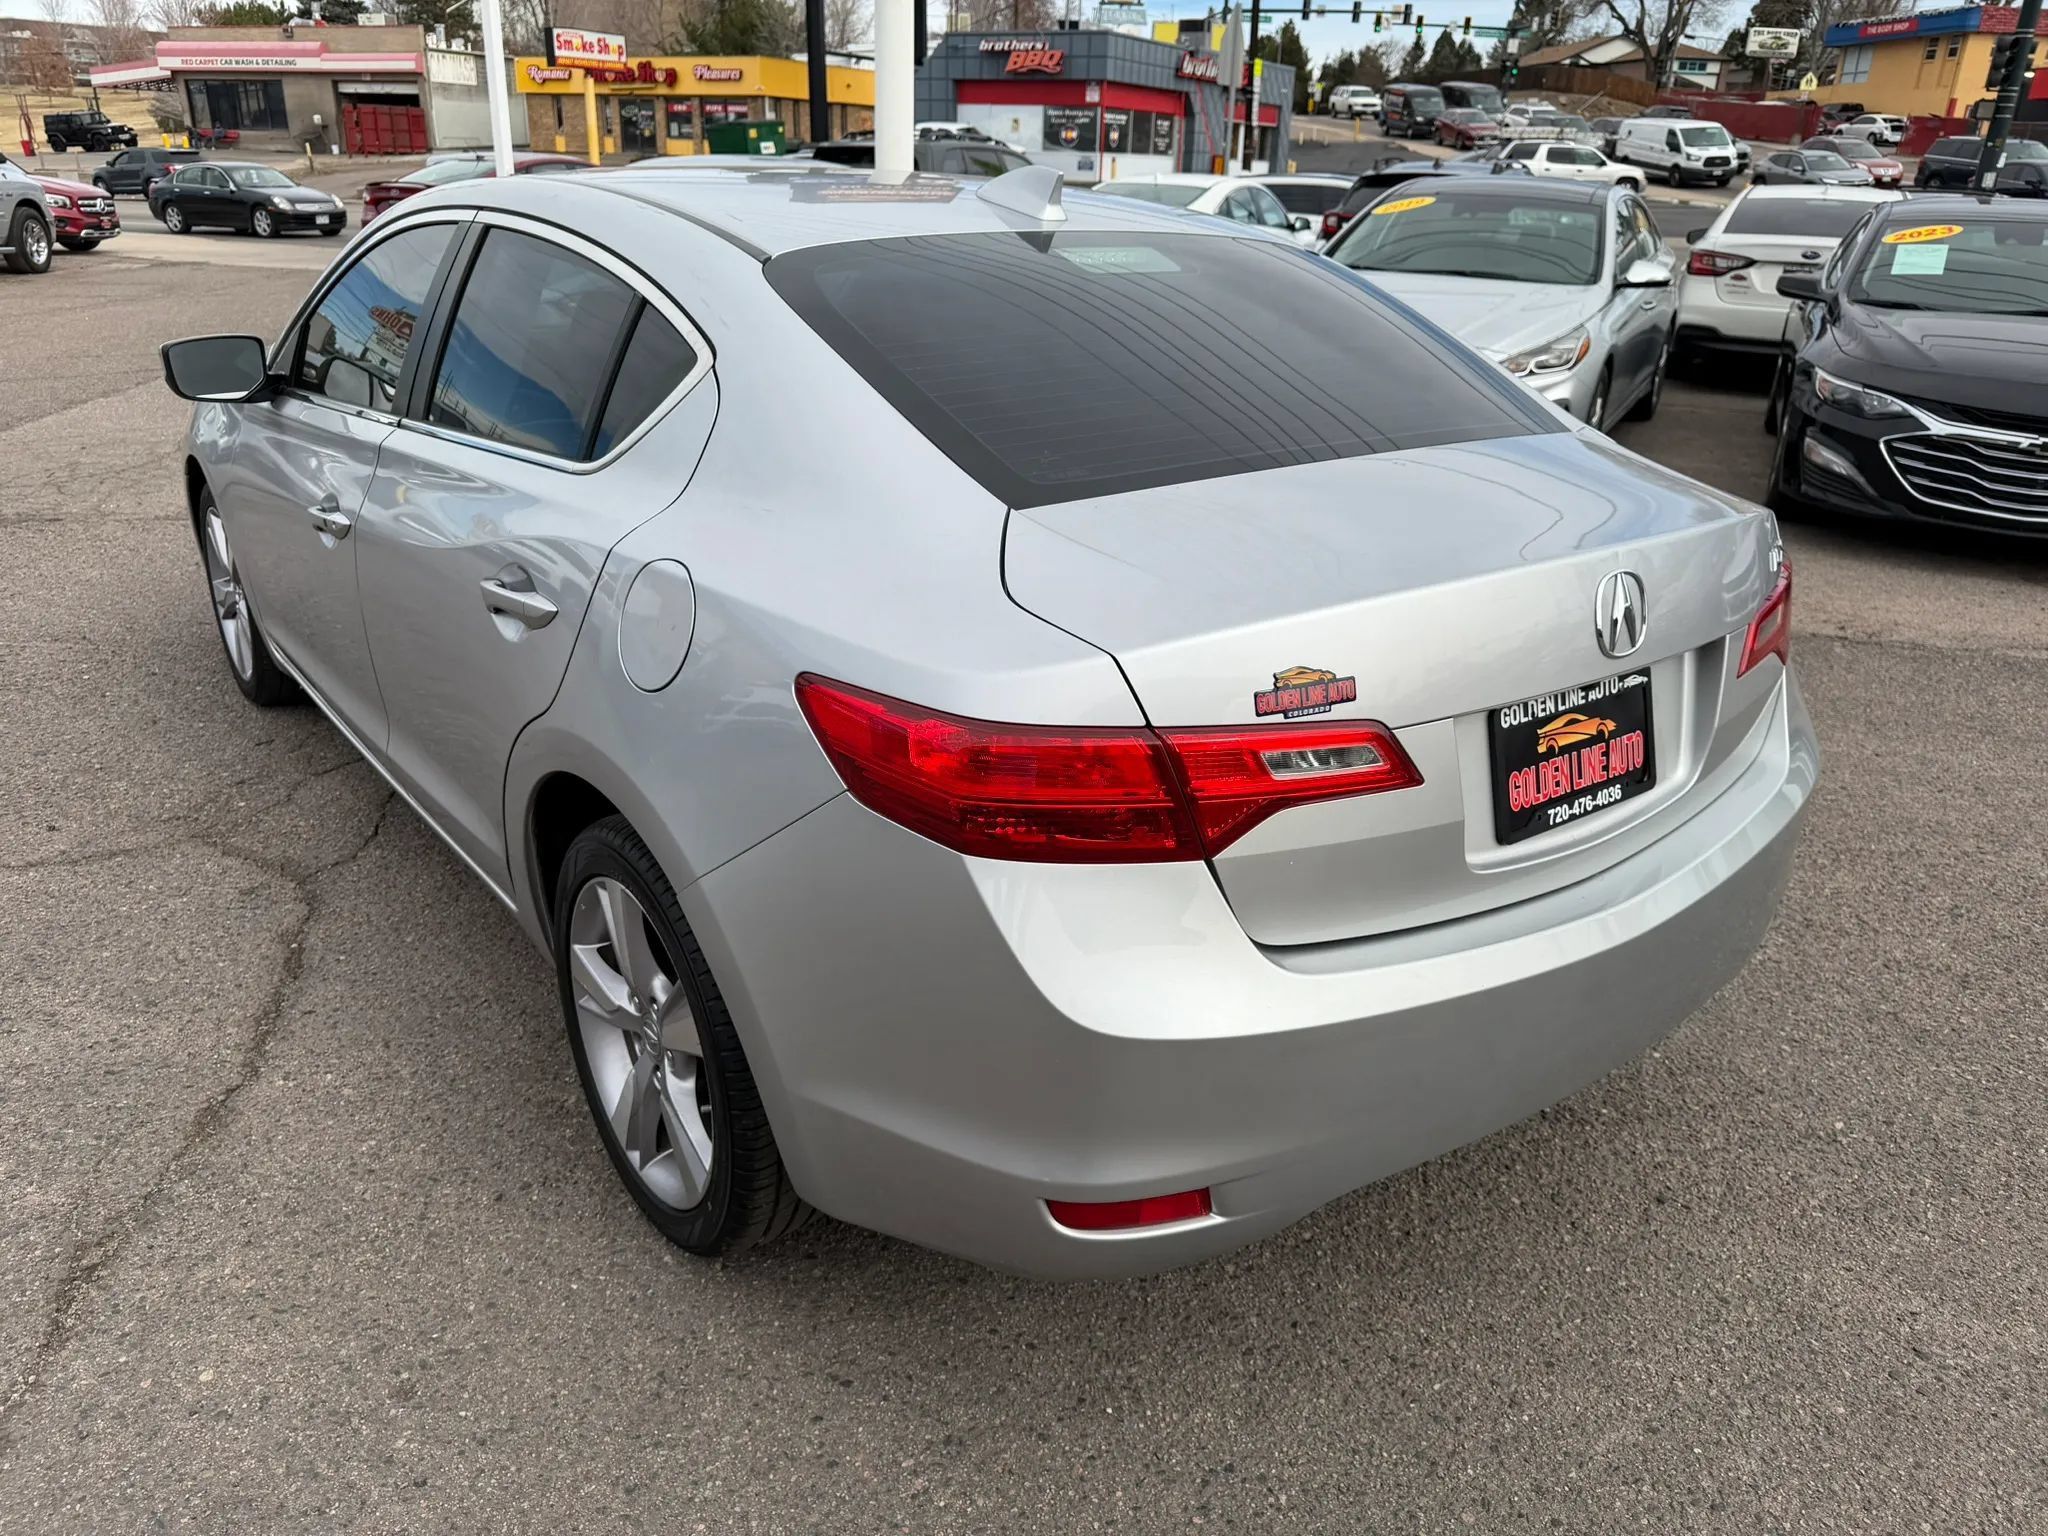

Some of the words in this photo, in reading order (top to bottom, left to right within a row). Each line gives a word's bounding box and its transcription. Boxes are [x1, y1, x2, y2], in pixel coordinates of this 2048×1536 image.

[979, 40, 1050, 51] brothers
[180, 58, 193, 66] RED
[194, 58, 219, 66] CARPET
[219, 58, 233, 66] CAR
[234, 58, 255, 66] WASH
[261, 59, 297, 67] DETAILING
[1005, 50, 1065, 73] BBQ
[528, 65, 571, 84] Romance
[693, 65, 742, 81] Pleasures
[1893, 226, 1954, 240] 2023
[1256, 688, 1301, 714] GOLDEN
[1302, 684, 1327, 707] LINE
[1328, 680, 1355, 701] AUTO
[1500, 696, 1556, 729] GOLDEN
[1557, 688, 1586, 712] LINE
[1588, 676, 1619, 702] AUTO
[1288, 705, 1330, 718] COLORADO
[1508, 754, 1571, 812] GOLDEN
[1571, 742, 1608, 790] LINE
[1608, 730, 1644, 779] AUTO
[1547, 784, 1622, 826] 720-476-4036
